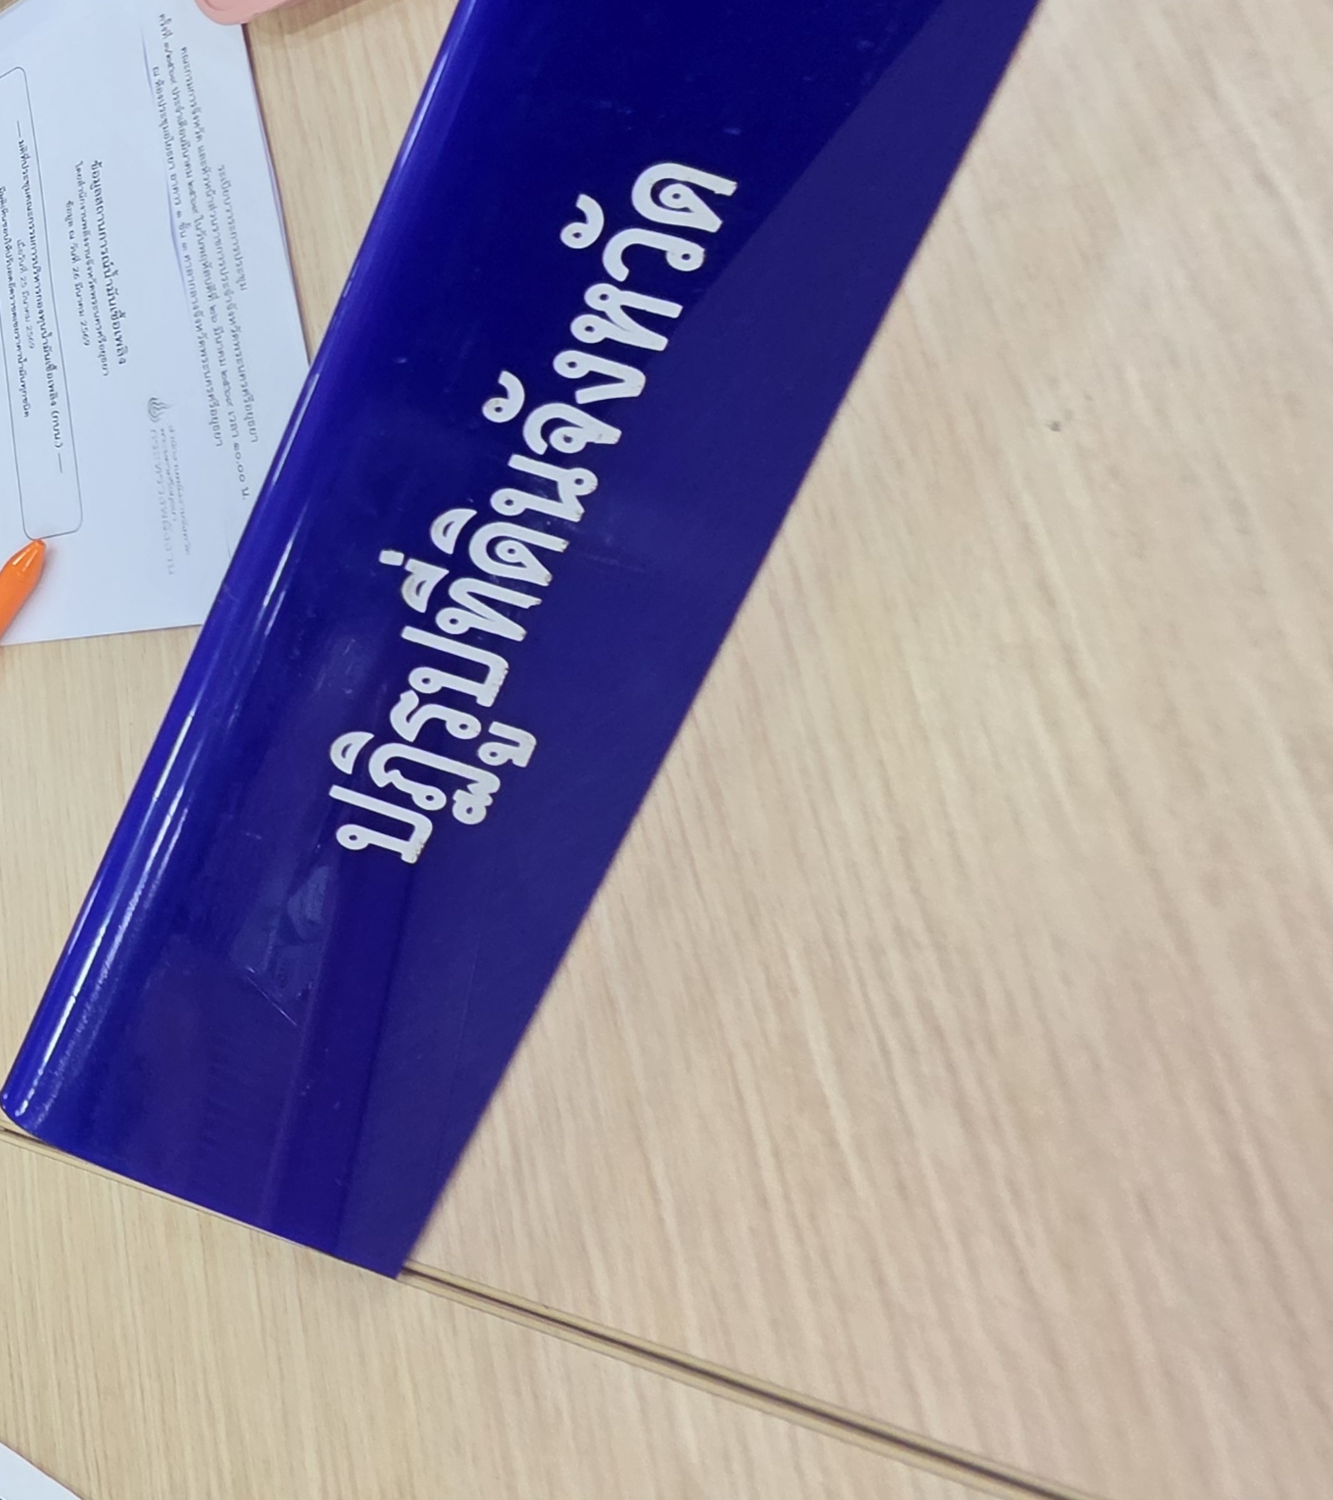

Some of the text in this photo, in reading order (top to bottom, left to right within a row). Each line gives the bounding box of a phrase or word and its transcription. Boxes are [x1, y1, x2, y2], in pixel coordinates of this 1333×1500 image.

[88, 160, 129, 365] ข้อมูลสถานการณ์น้ำมันเชื้อเพลิง
[217, 165, 248, 291] ระเบียบวาระการประชุม
[240, 486, 252, 501] น.
[329, 161, 737, 865] ปฏิรูปที่ดินจังหวัด
